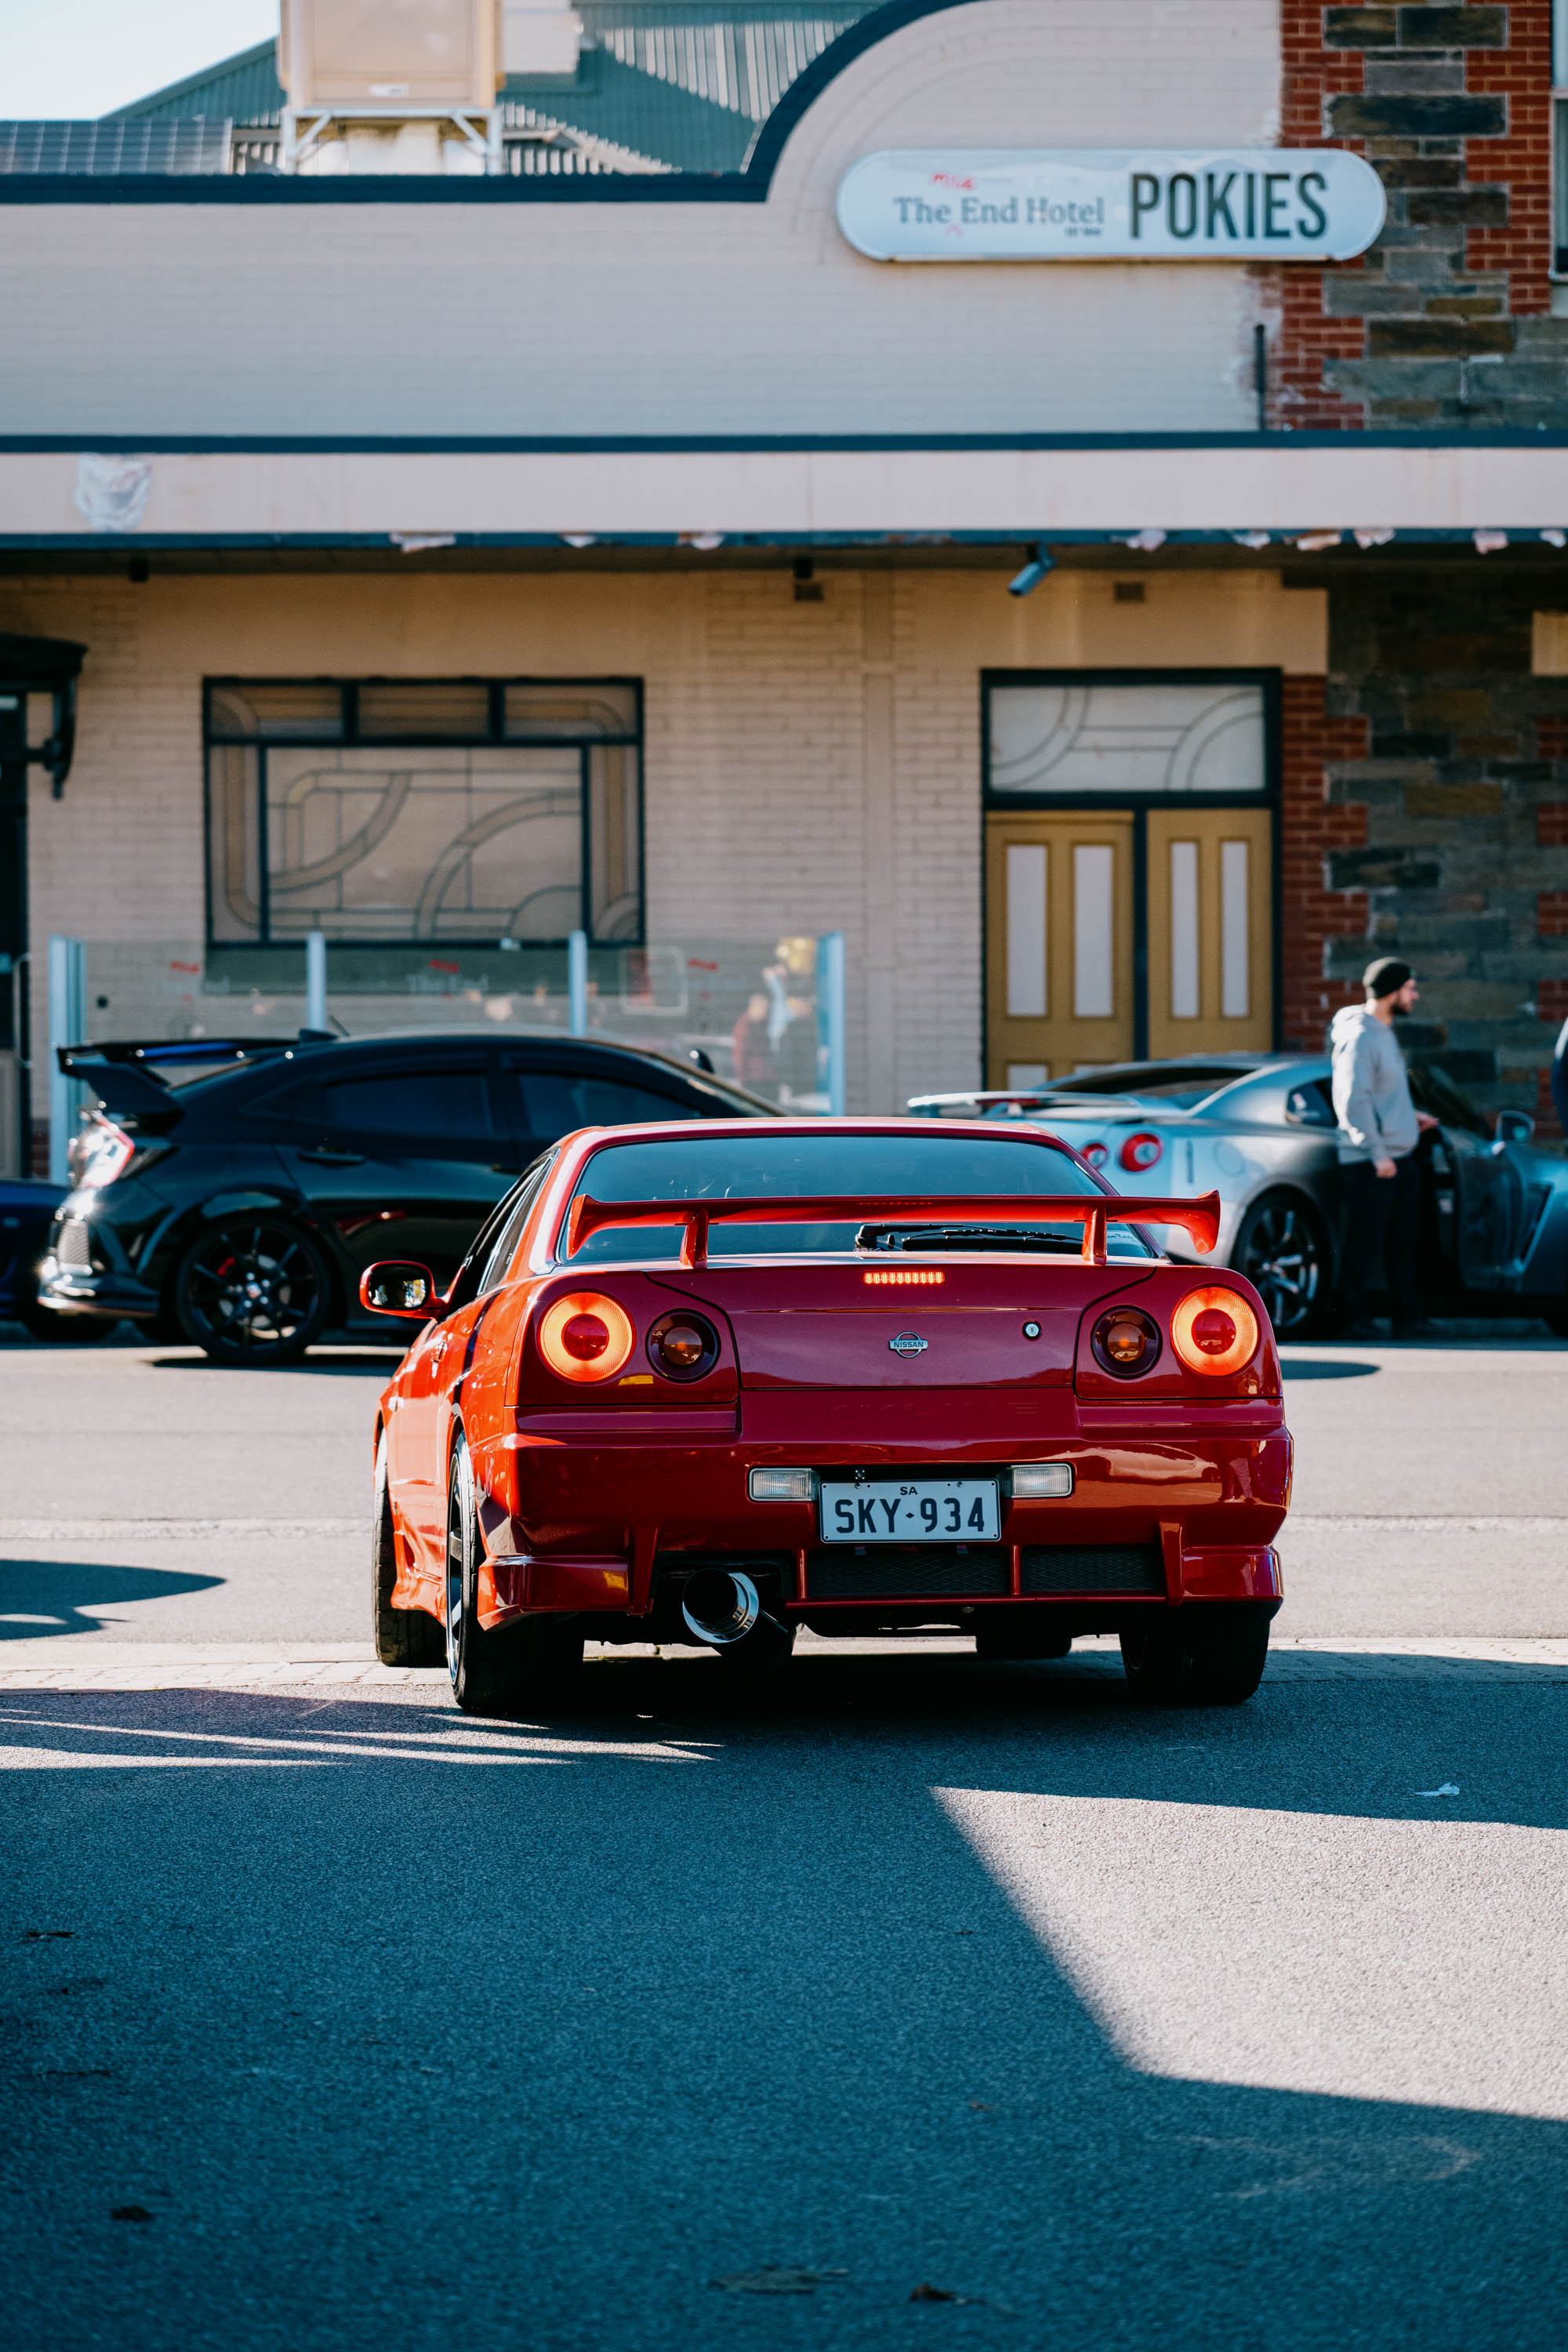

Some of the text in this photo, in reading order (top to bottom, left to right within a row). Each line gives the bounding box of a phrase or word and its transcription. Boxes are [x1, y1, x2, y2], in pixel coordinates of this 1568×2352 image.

[893, 195, 1105, 225] The End Hotel
[1131, 172, 1327, 240] POKIES
[899, 1486, 918, 1496] SA
